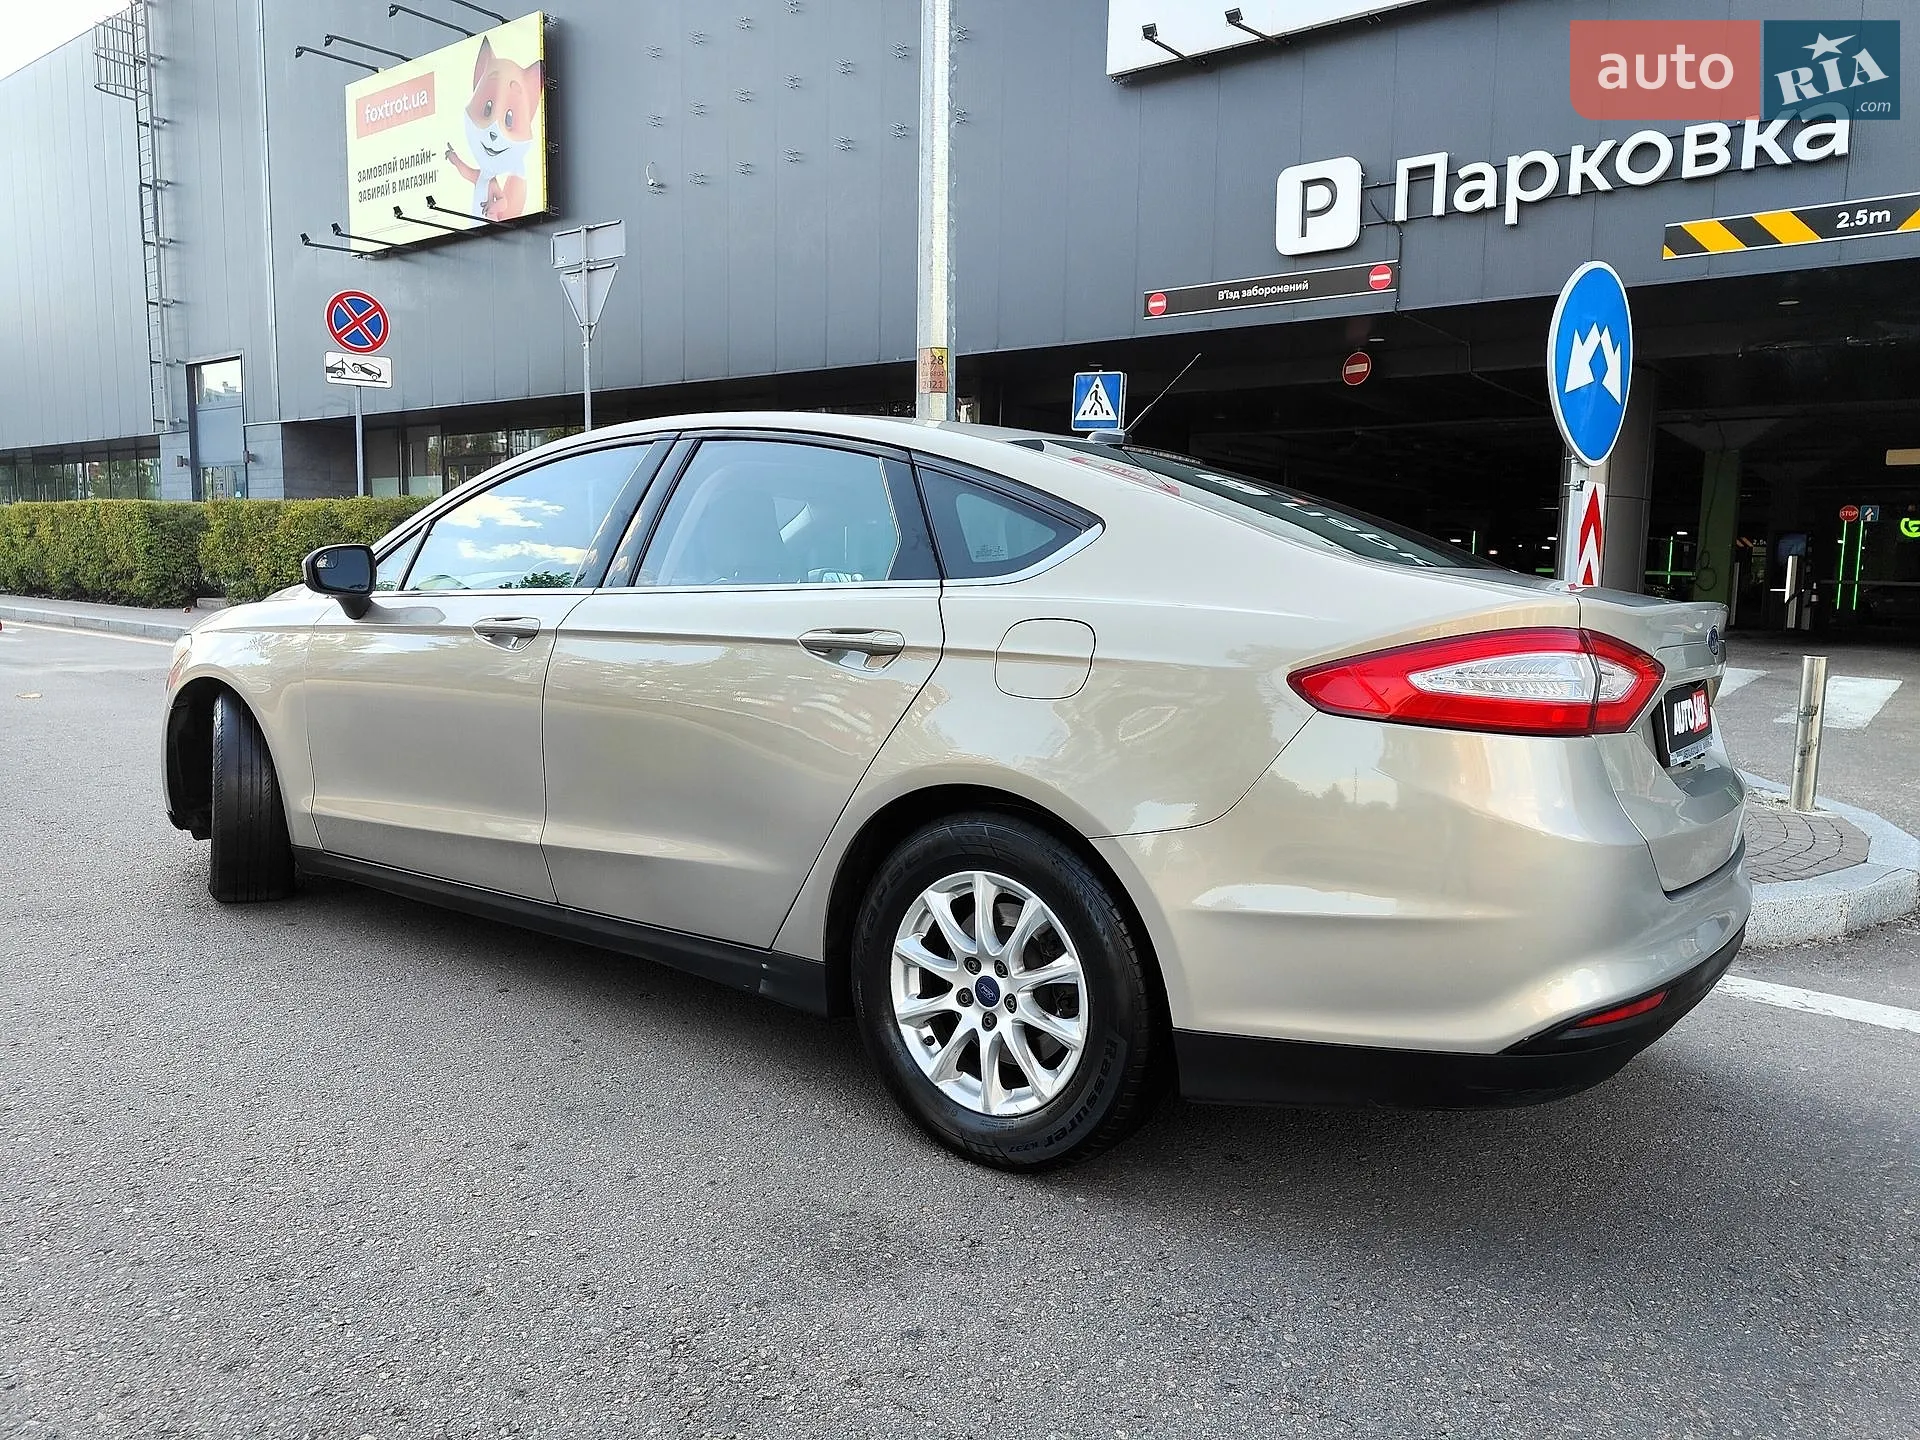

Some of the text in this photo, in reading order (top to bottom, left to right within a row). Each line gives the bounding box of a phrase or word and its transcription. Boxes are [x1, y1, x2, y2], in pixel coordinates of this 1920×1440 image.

[364, 89, 428, 124] foxtrot.ua
[1394, 101, 1850, 226] Парковка
[358, 179, 391, 203] ЗАБИРАЙ
[392, 181, 397, 194] В
[1836, 208, 1891, 229] 2.5m
[1241, 280, 1309, 299] заборонений
[1673, 698, 1695, 736] AUTO
[1045, 1039, 1119, 1148] Rassurer
